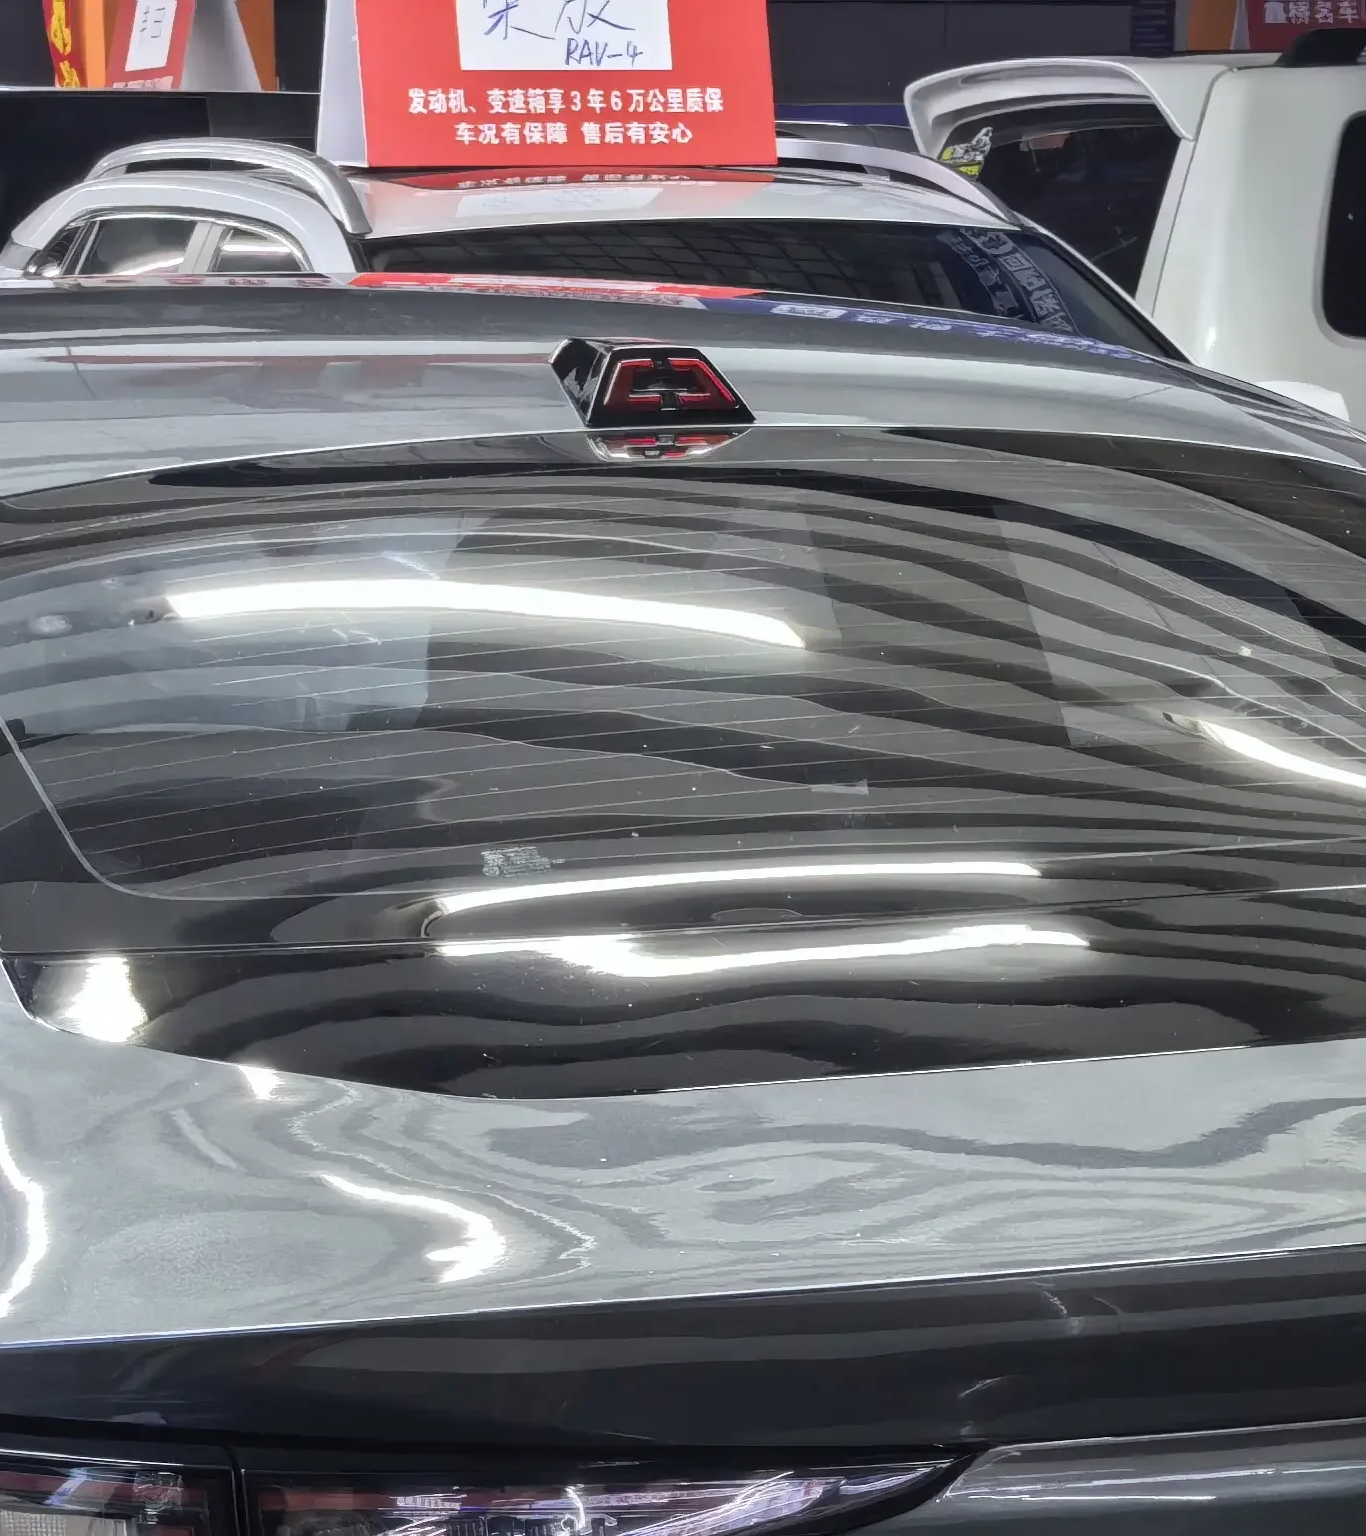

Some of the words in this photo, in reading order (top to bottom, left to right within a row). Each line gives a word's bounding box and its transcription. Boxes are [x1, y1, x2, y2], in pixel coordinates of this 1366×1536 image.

[565, 37, 643, 66] RAV-4
[408, 88, 724, 114] 发动机、变速箱享3年6万公里质保
[455, 122, 568, 145] 车况有保障
[580, 121, 693, 145] 售后有安心
